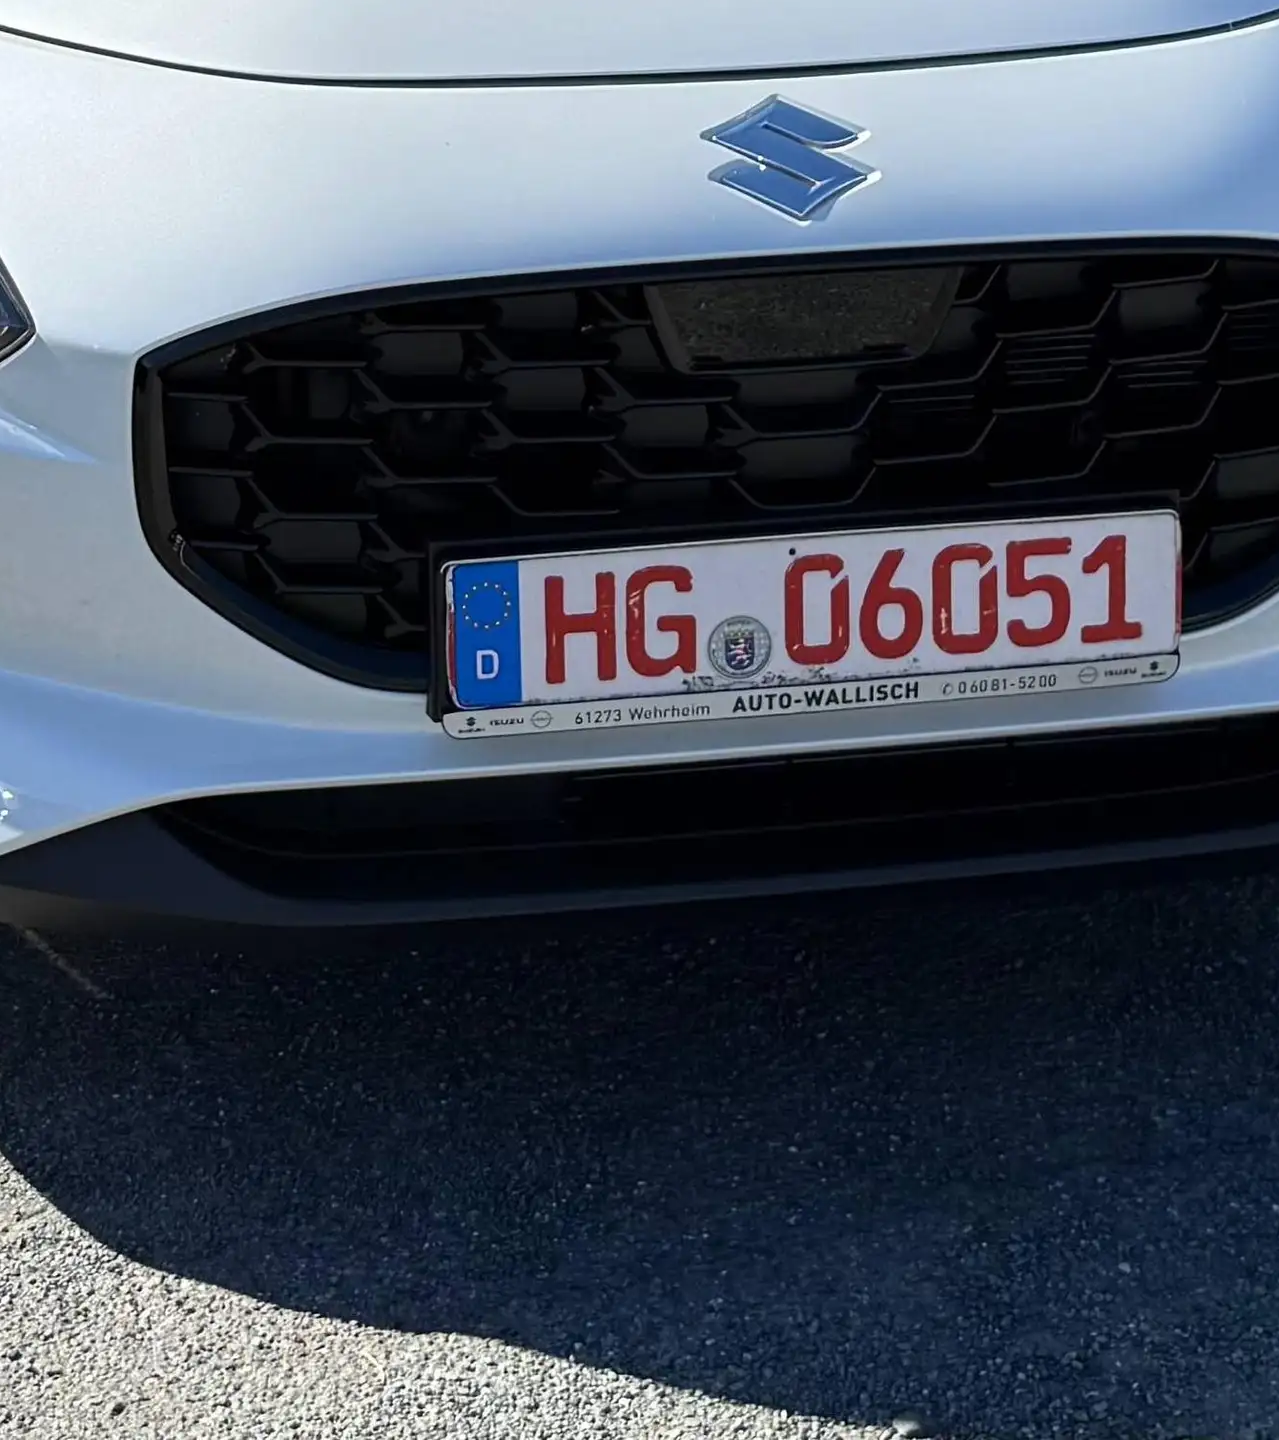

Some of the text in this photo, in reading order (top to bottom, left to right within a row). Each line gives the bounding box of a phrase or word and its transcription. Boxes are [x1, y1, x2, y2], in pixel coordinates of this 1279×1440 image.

[544, 535, 1143, 684] HG 06051
[476, 650, 499, 679] D
[575, 710, 622, 725] 61273
[629, 704, 711, 722] Wehrheim
[732, 682, 919, 713] AUTO-WALLISCH
